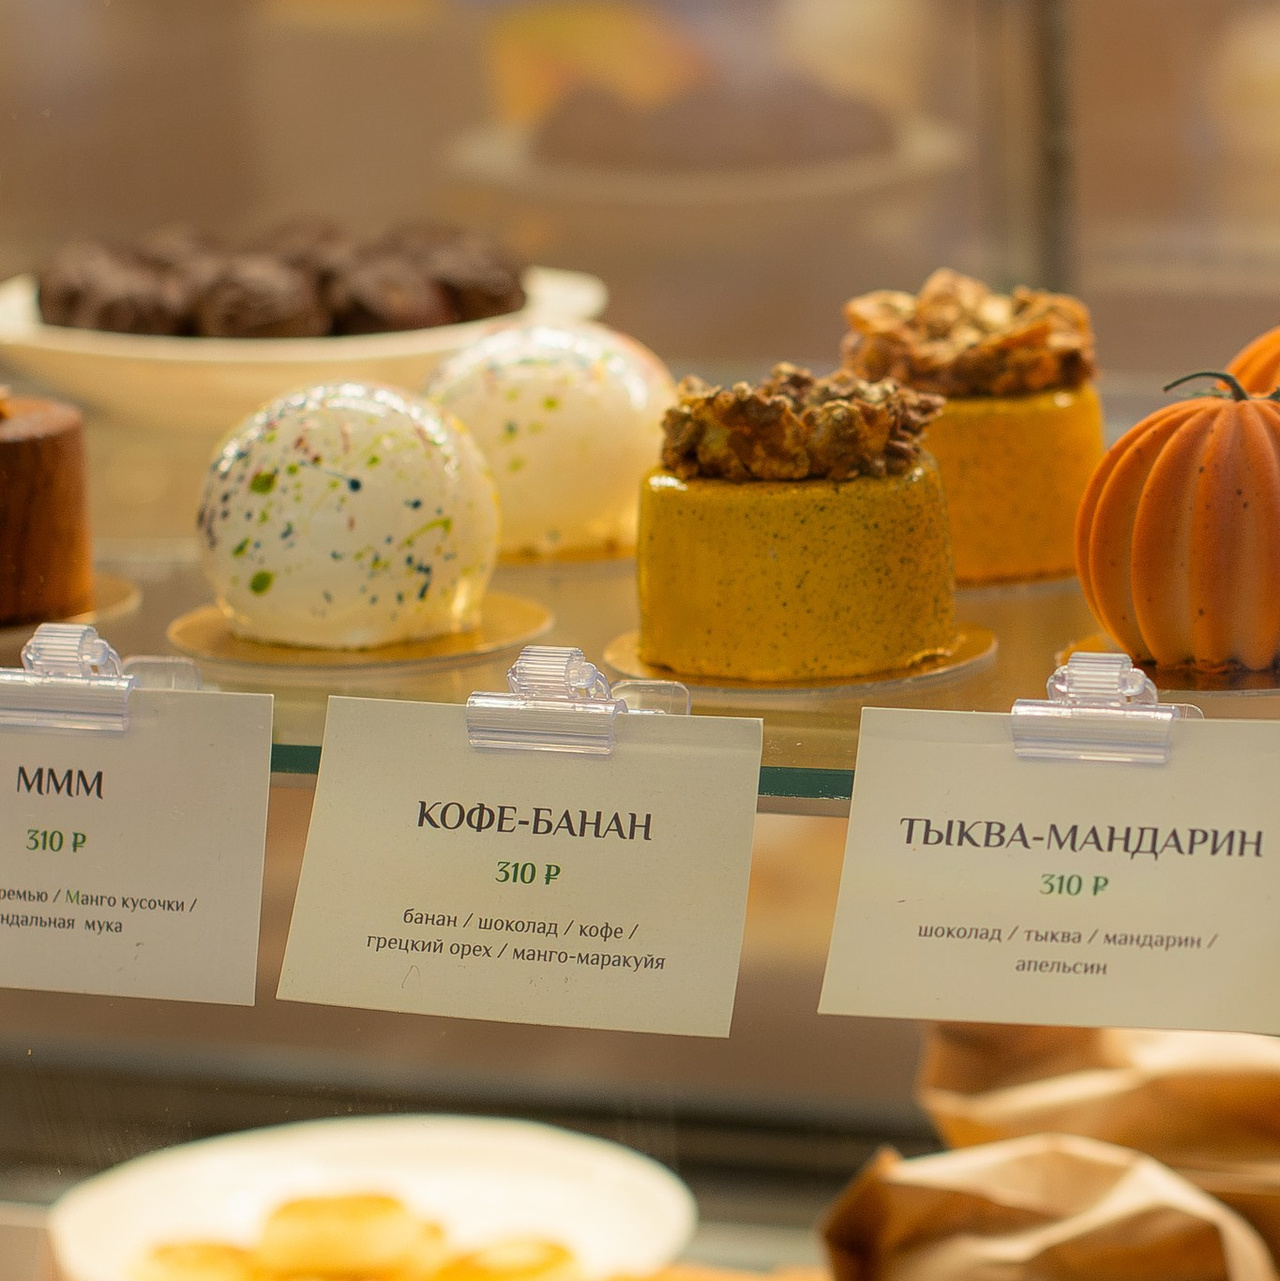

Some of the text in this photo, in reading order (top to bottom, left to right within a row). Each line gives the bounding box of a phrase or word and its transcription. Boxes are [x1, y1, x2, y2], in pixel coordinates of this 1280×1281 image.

[17, 766, 103, 799] МММ
[418, 801, 652, 840] КОФЕ-БАНАН
[26, 829, 63, 852] 310
[900, 817, 1263, 861] ТЫКВА-МАНДАРИН
[495, 862, 536, 884] 310
[1039, 873, 1082, 896] 310
[66, 890, 116, 907] Манго
[122, 897, 184, 912] кусочки
[84, 920, 122, 934] мука
[403, 909, 458, 927] банан
[478, 915, 558, 936] шоколад
[579, 922, 623, 942] кофе
[918, 924, 1002, 942] шоколад
[1024, 929, 1082, 944] тыква
[1103, 932, 1201, 951] мандарин
[366, 935, 443, 954] грецкий
[450, 941, 492, 958] орех
[513, 948, 666, 972] манго-маракуйя
[1015, 959, 1108, 975] апельсин
